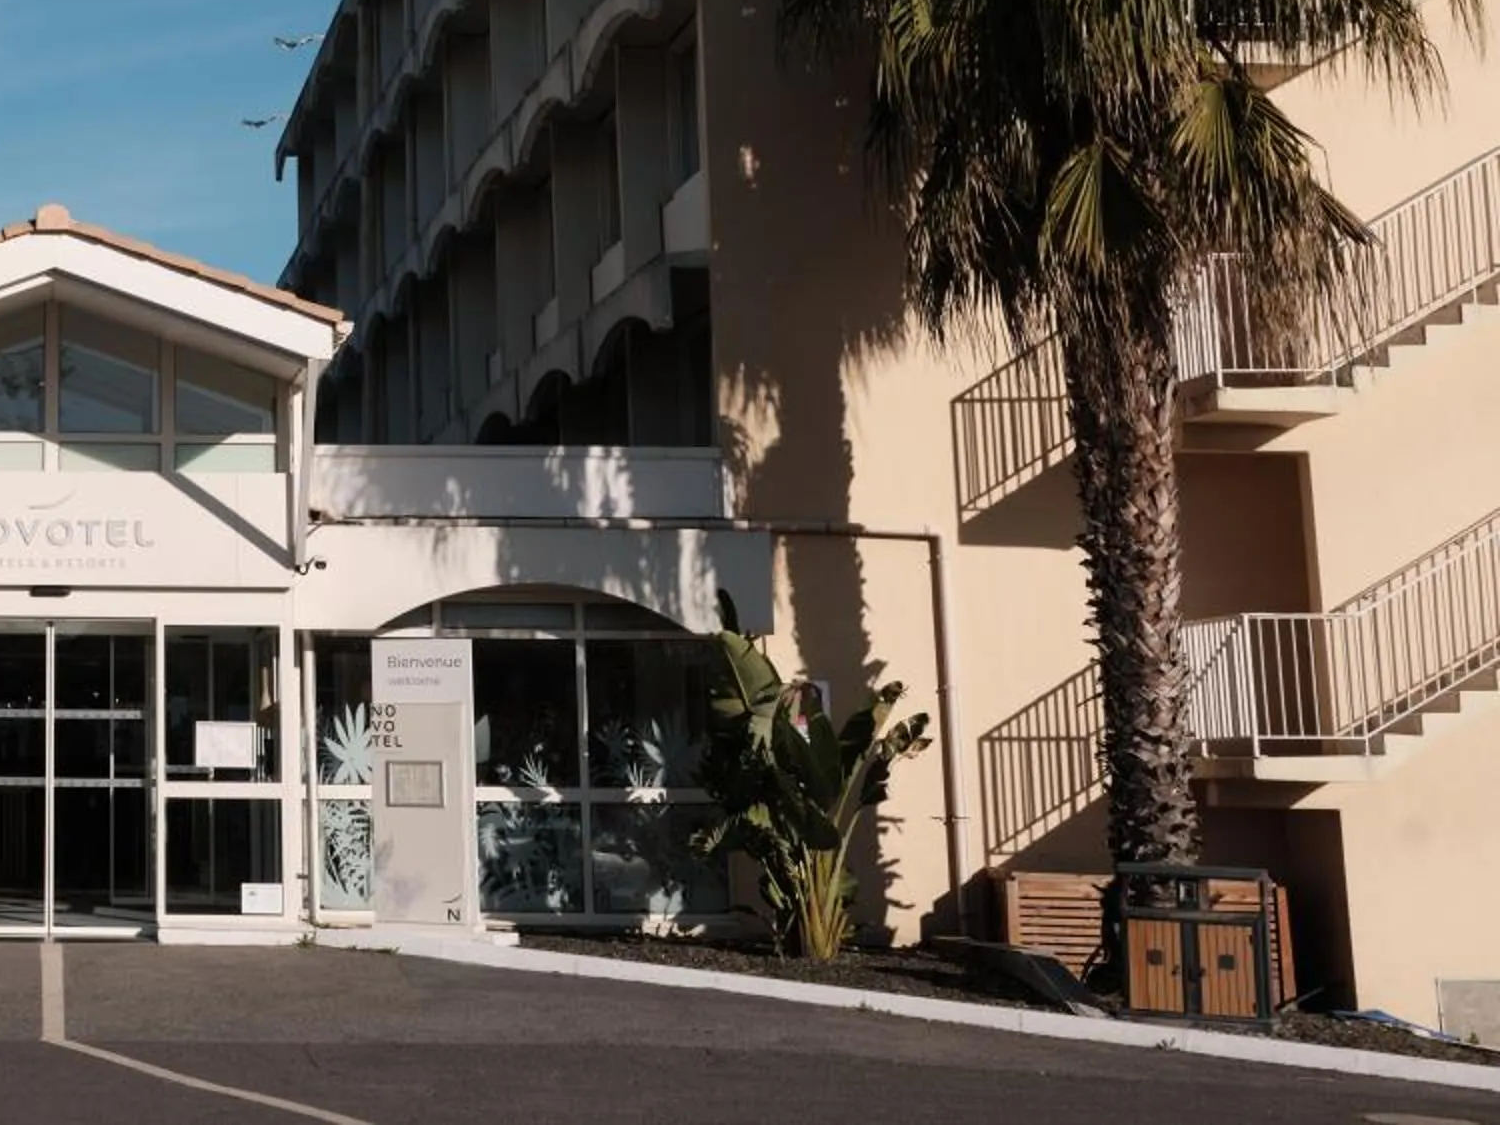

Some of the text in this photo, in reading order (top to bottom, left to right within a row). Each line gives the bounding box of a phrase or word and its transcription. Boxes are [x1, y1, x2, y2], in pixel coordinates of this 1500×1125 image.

[387, 655, 463, 668] Bienvenue
[371, 704, 396, 717] NO
[371, 720, 395, 733] VO
[372, 734, 403, 748] TEL
[447, 909, 461, 922] N
